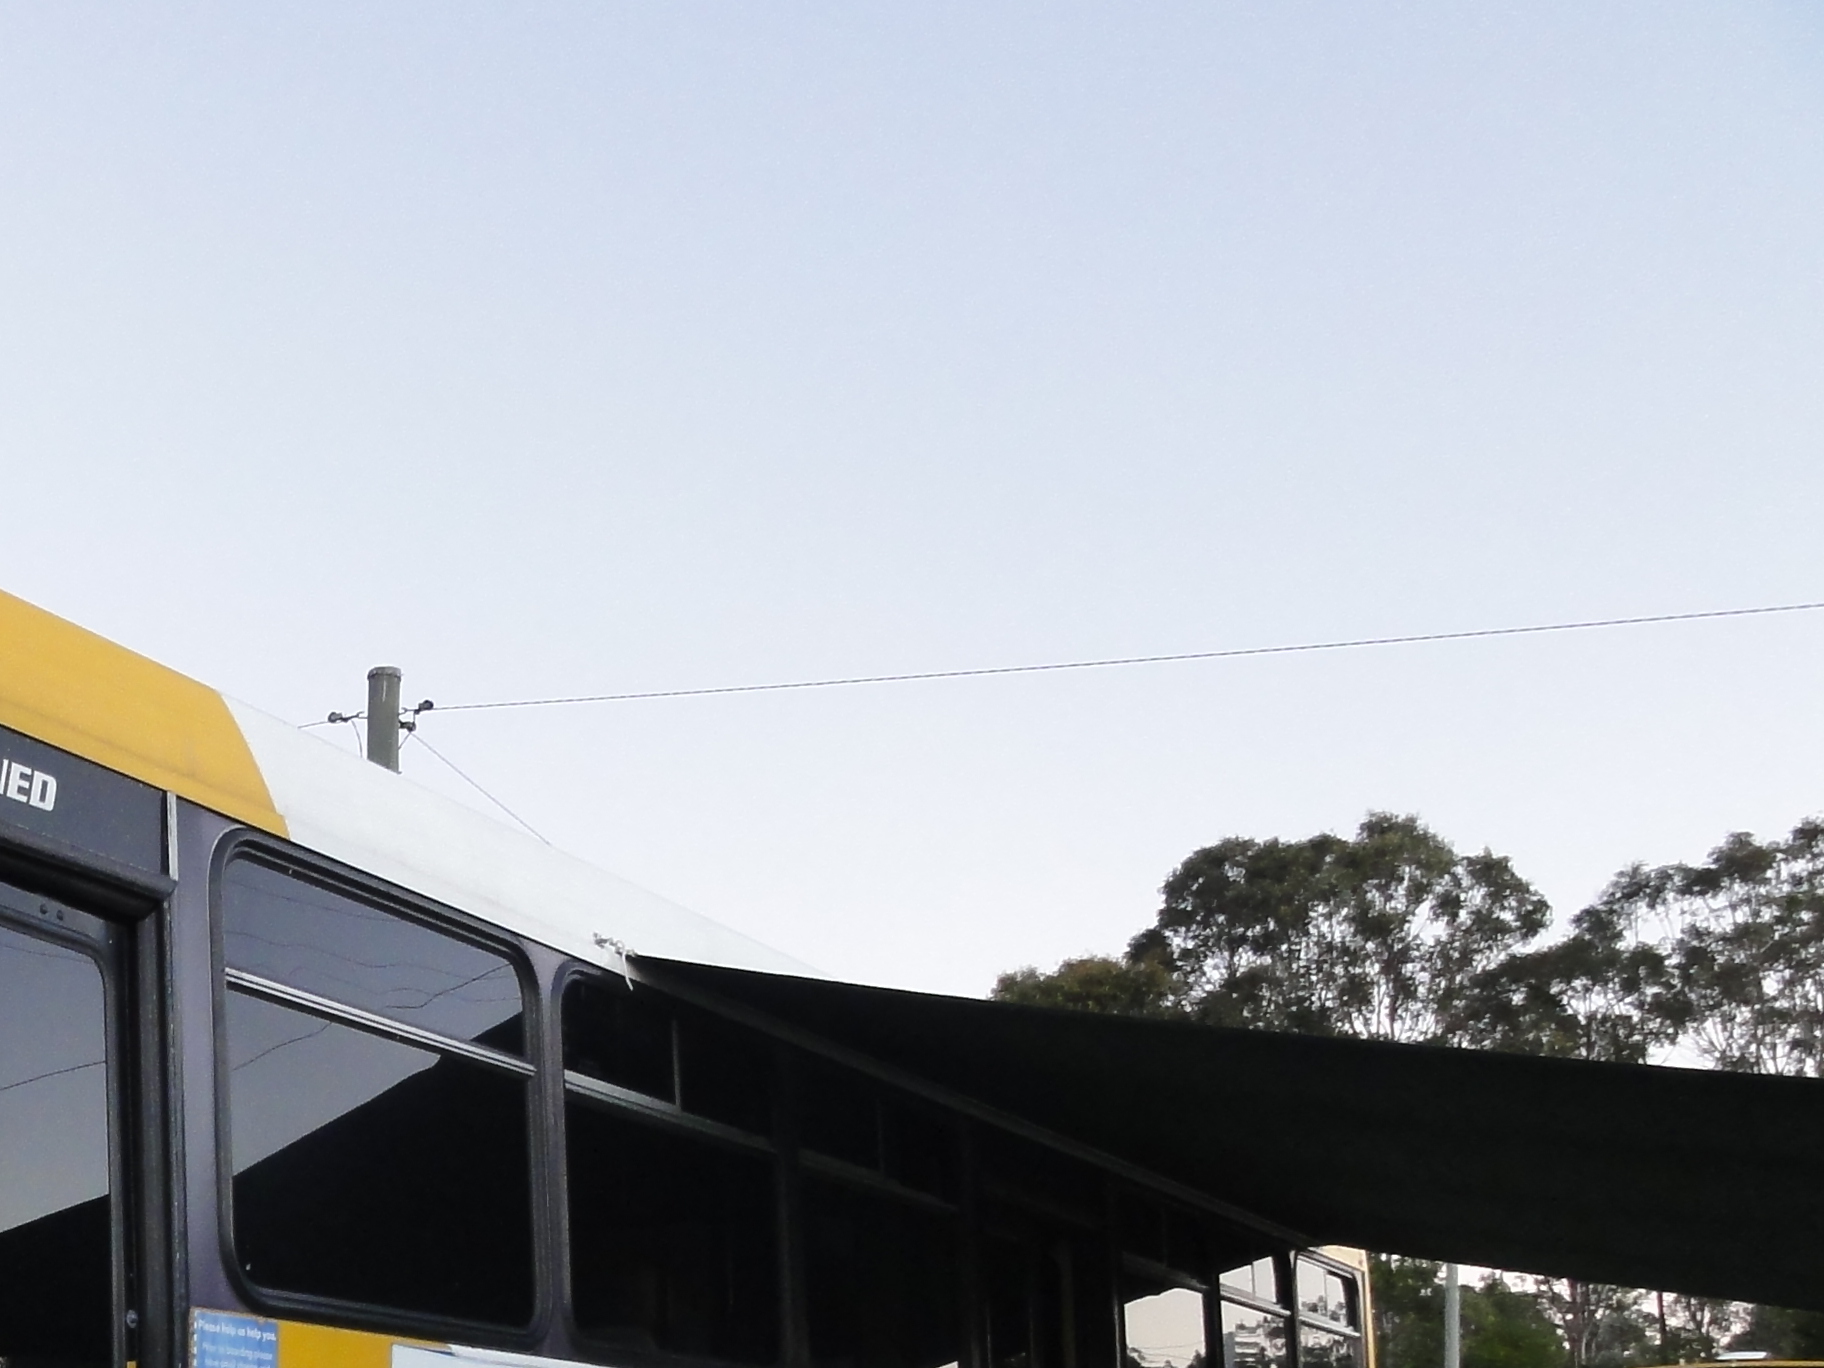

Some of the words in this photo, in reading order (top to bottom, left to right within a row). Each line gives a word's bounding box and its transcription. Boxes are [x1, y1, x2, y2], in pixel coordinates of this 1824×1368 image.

[198, 1319, 221, 1334] Please
[221, 1322, 236, 1337] help
[237, 1328, 246, 1337] us
[246, 1326, 262, 1341] help
